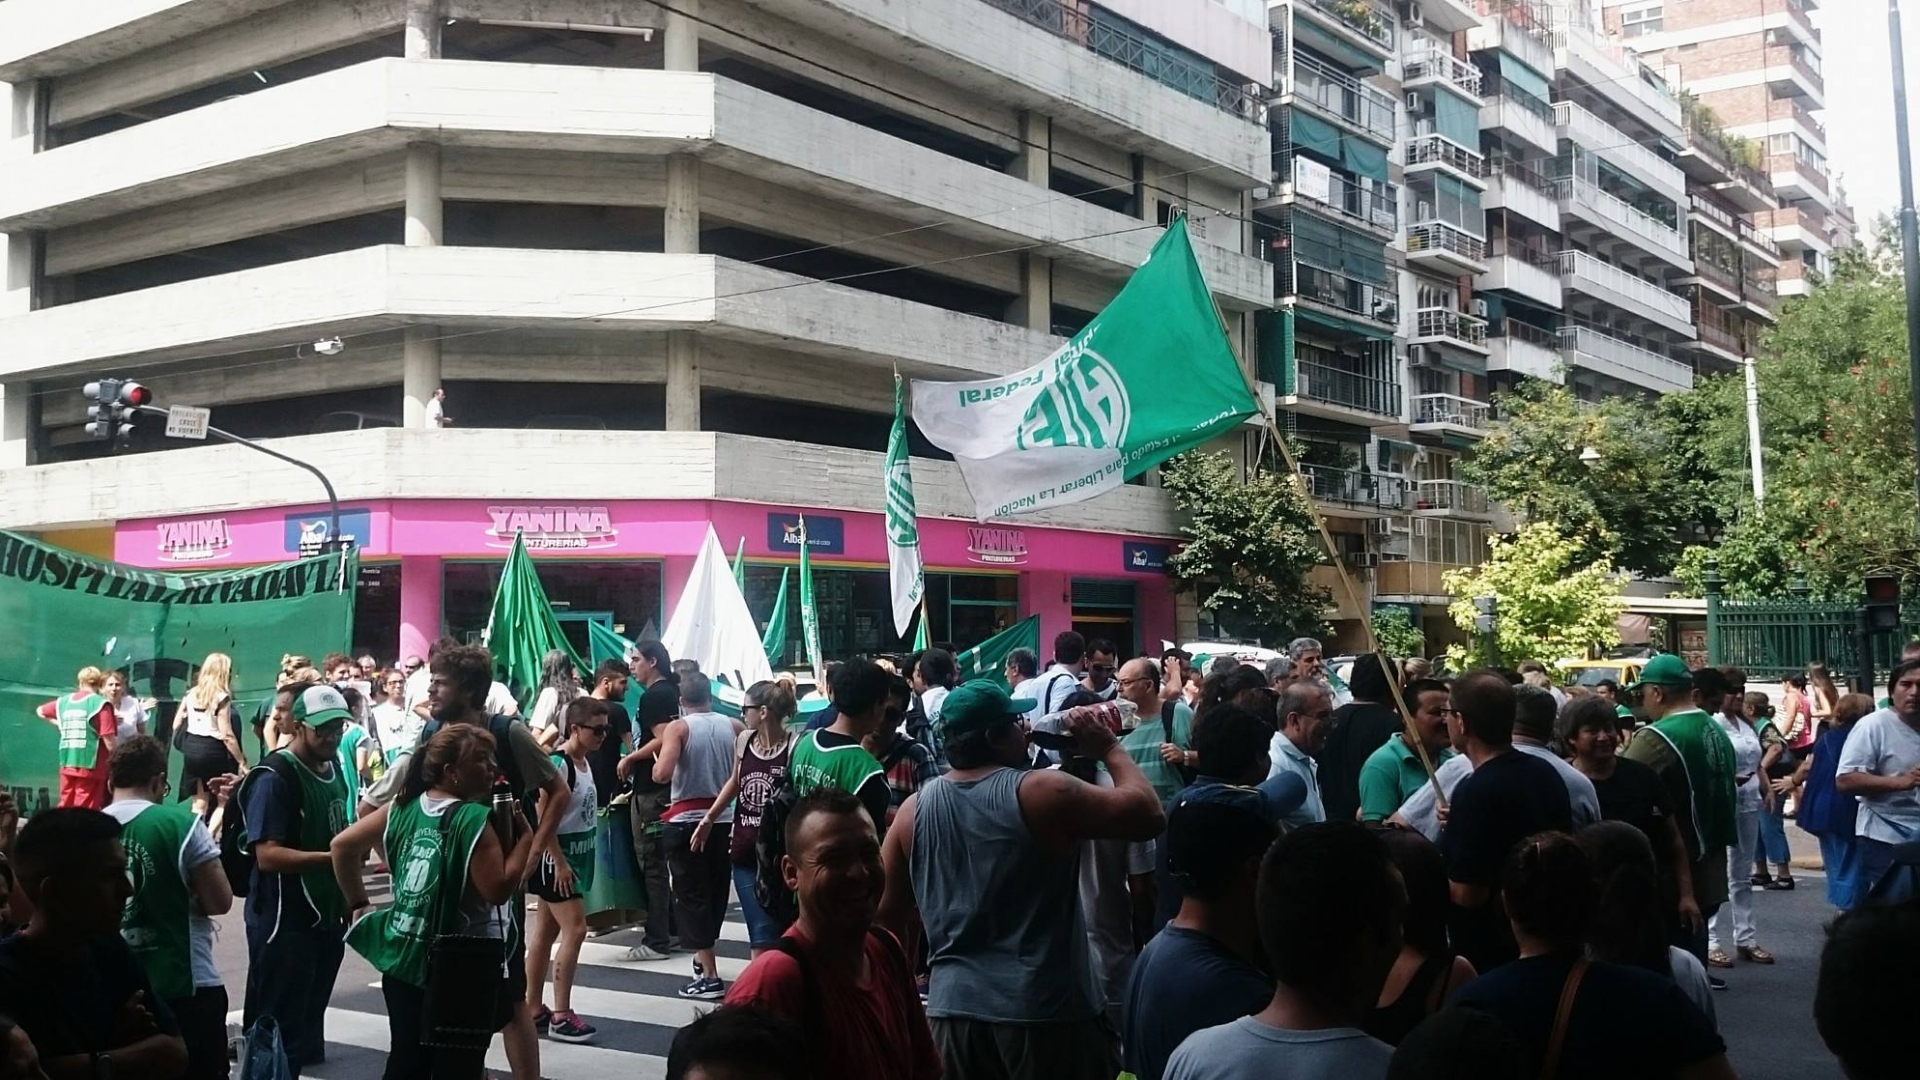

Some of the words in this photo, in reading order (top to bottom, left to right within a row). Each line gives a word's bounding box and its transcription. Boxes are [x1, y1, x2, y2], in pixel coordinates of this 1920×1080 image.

[959, 370, 1044, 408] Federal
[1105, 452, 1129, 475] para
[1039, 488, 1055, 500] La
[1058, 469, 1104, 495] Liberar
[994, 493, 1036, 518] Nación
[487, 505, 614, 534] YANINA
[157, 518, 229, 548] YANINA
[299, 530, 324, 545] Alba
[783, 531, 802, 544] Alba
[967, 527, 1026, 552] YANINA
[0, 532, 183, 604] HOSPITAL
[1132, 556, 1146, 566] Alba
[747, 781, 769, 804] ATE
